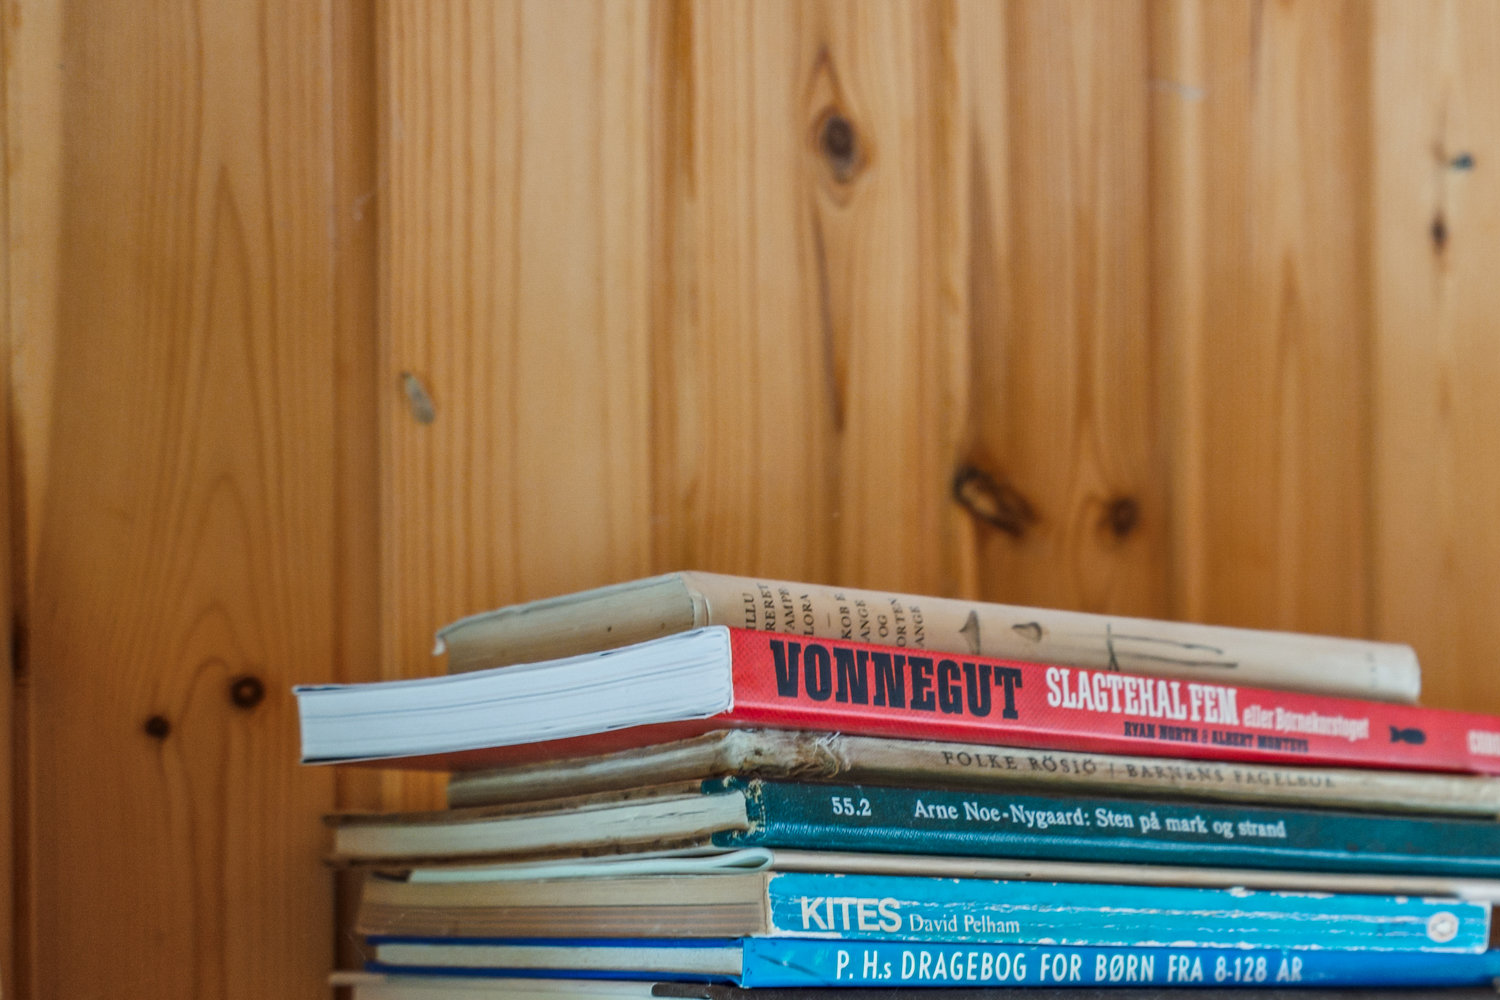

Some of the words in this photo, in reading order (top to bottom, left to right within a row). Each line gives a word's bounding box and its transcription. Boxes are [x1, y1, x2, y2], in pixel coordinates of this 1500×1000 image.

[800, 593, 815, 637] LORA
[839, 606, 852, 640] KOB
[856, 599, 871, 643] ANGE
[877, 614, 889, 638] OG
[909, 605, 925, 649] ANGE
[770, 640, 1022, 720] VONNEGUT
[1046, 667, 1187, 721] SLAGTEHAL
[1188, 683, 1239, 726] FEM
[1242, 704, 1275, 729] eller
[1124, 721, 1156, 739] RYAN
[1159, 725, 1198, 743] NORTH
[1211, 731, 1254, 748] ALBERT
[942, 751, 1018, 770] FOLKE
[1126, 764, 1224, 782] BARNENS
[831, 797, 872, 817] 55.2
[914, 799, 959, 819] Arne
[963, 802, 1091, 829] Noe-Nygaard:
[1095, 808, 1134, 828] Sten
[1139, 811, 1161, 833] på
[1165, 815, 1208, 834] mark
[1213, 821, 1234, 839] og
[1237, 820, 1287, 838] strand
[800, 896, 901, 932] KITES
[909, 914, 957, 933] David
[963, 915, 1020, 934] Pelham
[836, 950, 854, 980] P.
[863, 950, 892, 980] H.s
[901, 950, 1027, 981] DRAGEBOG
[1040, 953, 1082, 982] FOR
[1094, 953, 1154, 982] BØRN
[1167, 954, 1203, 982] FRA
[1215, 956, 1267, 983] 8-128
